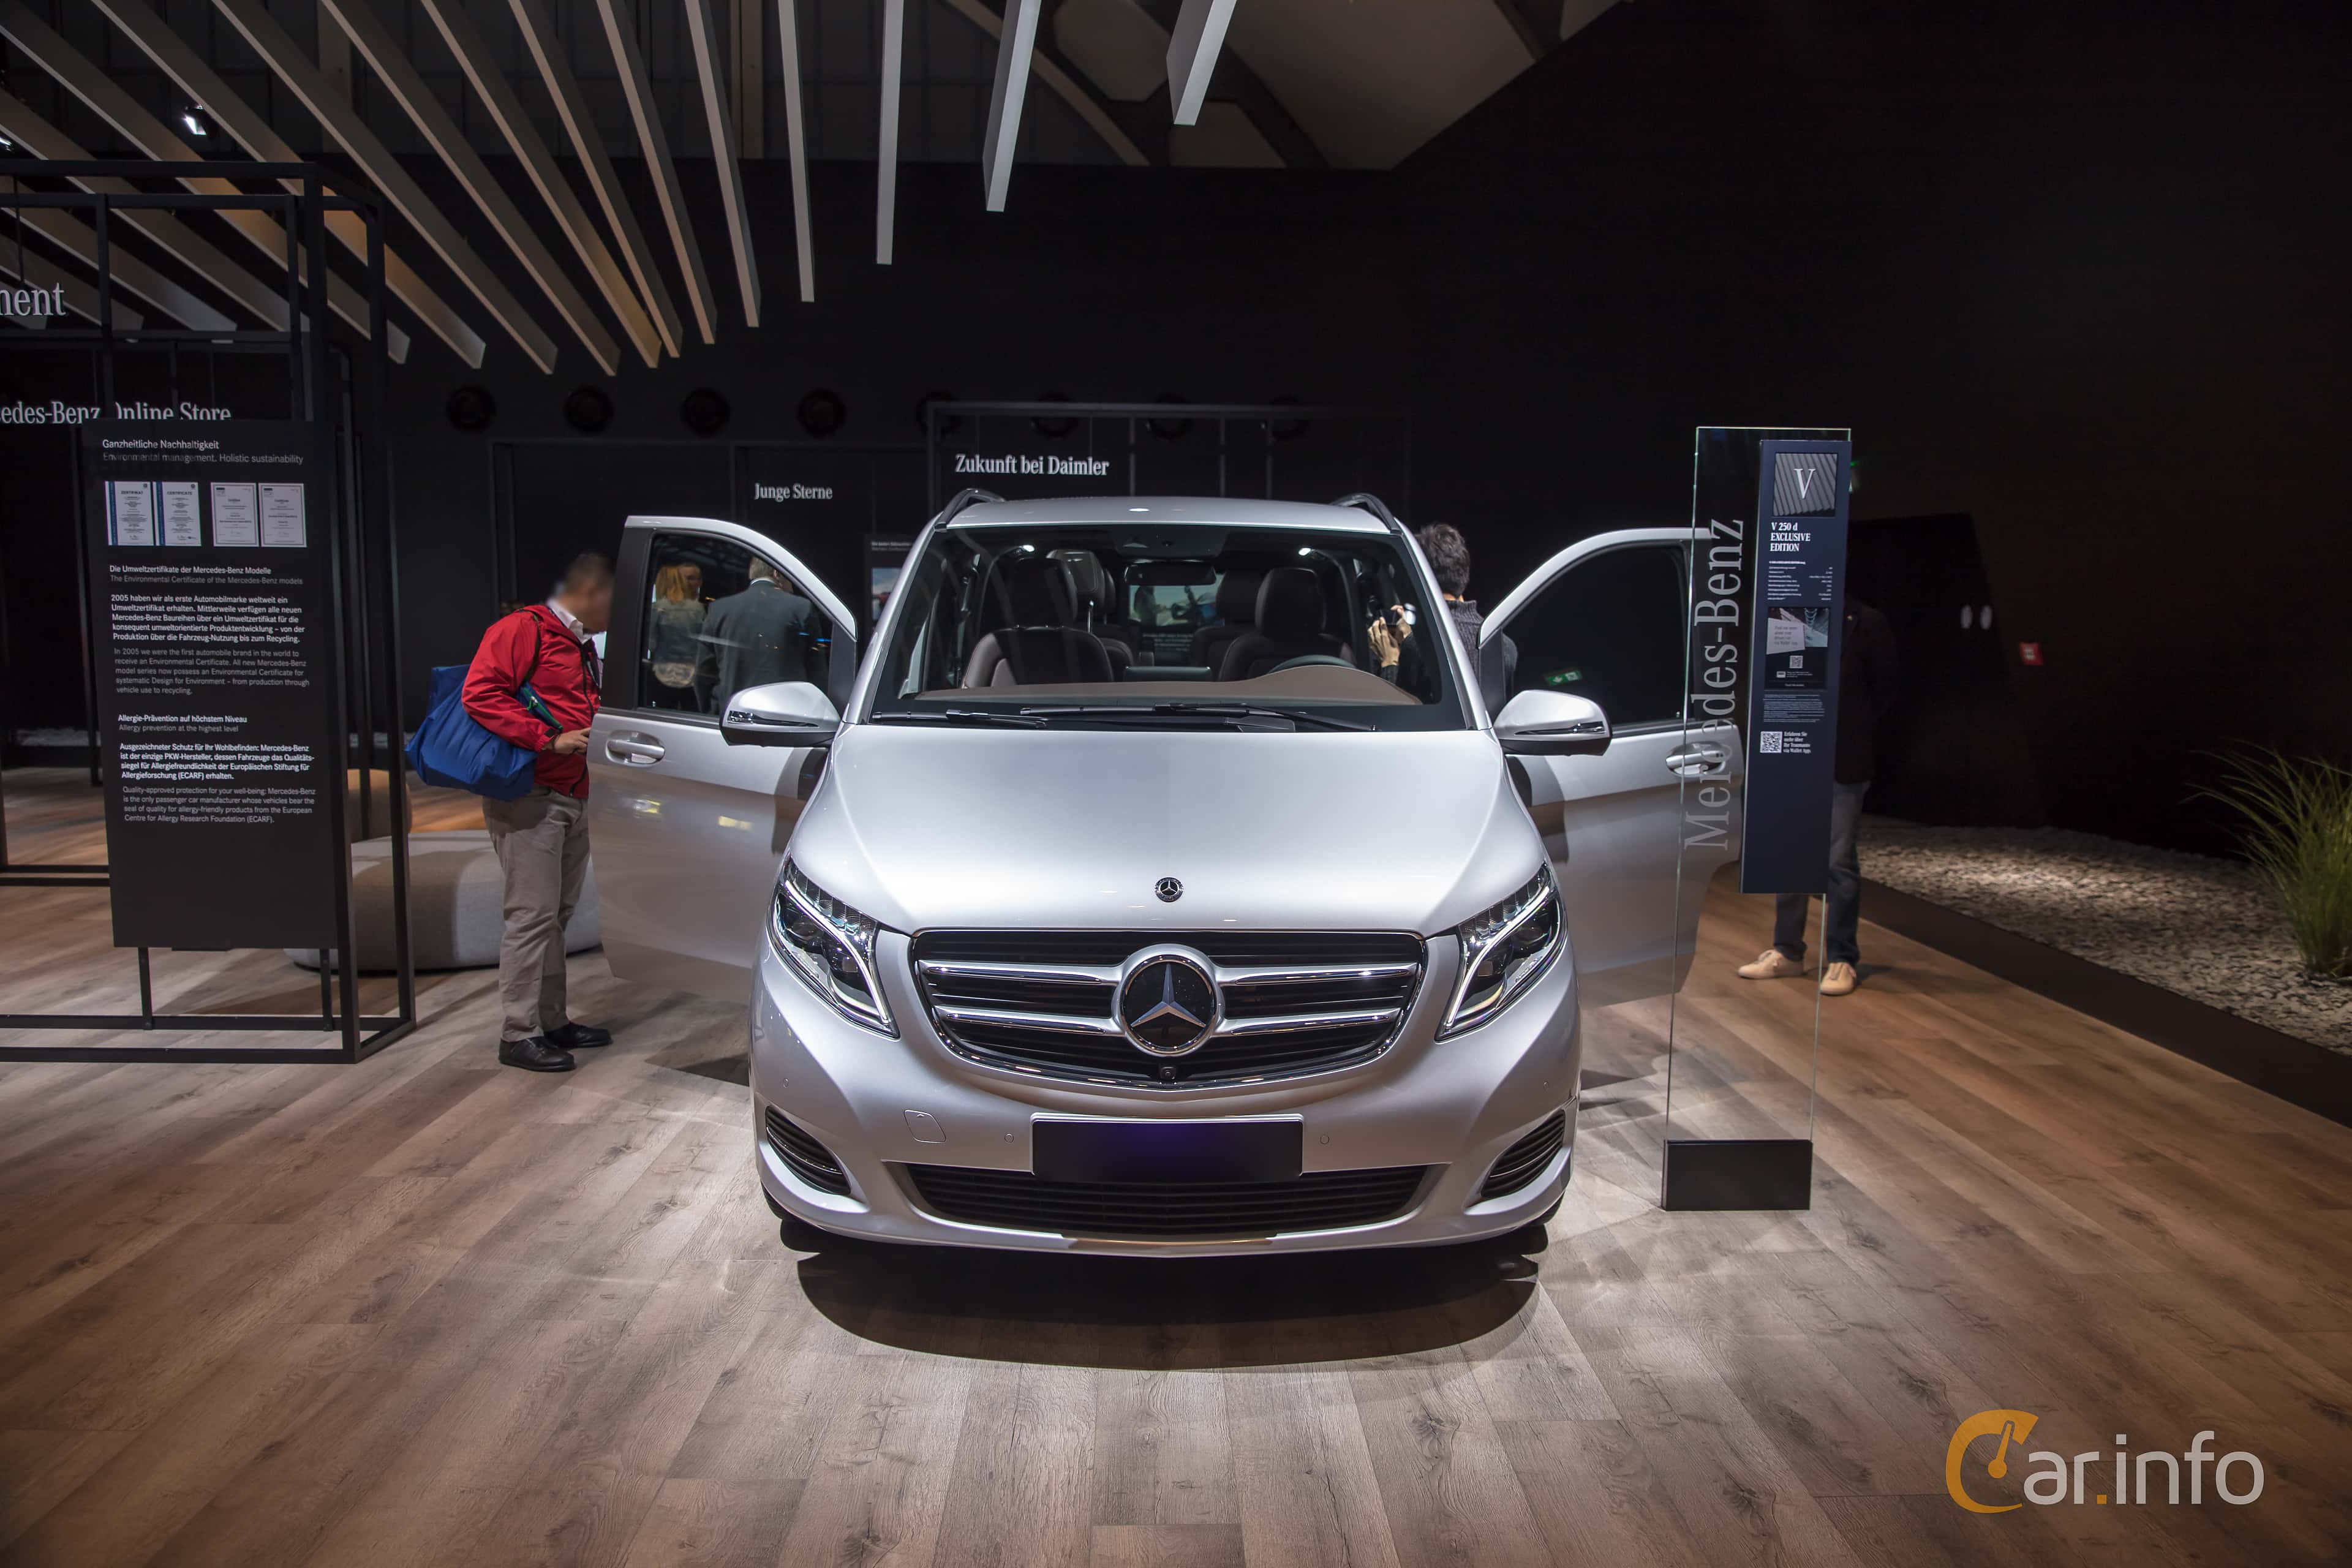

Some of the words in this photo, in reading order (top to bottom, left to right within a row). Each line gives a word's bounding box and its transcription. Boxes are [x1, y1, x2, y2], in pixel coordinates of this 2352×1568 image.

[0, 401, 101, 424] edes-Benz
[180, 402, 232, 420] Store
[102, 439, 158, 449] Ganzheitliche
[160, 439, 220, 451] Nachhaltigkeit
[103, 453, 160, 461] Environmental
[162, 453, 217, 464] management.
[219, 453, 249, 462] Holistic
[251, 454, 303, 465] sustainability
[956, 454, 1017, 473] Zukunft
[1020, 455, 1044, 474] bei
[1047, 456, 1109, 476] Daimler
[1793, 468, 1816, 499] V
[755, 483, 790, 502] Junge
[792, 484, 832, 499] Sterne
[1771, 522, 1777, 531] V
[1778, 522, 1792, 531] 250
[1792, 522, 1798, 531] d
[1770, 533, 1811, 542] EXCLUSIVE
[1770, 543, 1800, 552] EDITION
[238, 605, 266, 614] verfügen
[113, 624, 151, 632] konsequent
[179, 634, 239, 643] Fahrzeug-Nutzung
[266, 635, 300, 644] Recycling.
[1683, 519, 1744, 850] Mercedes-Benz
[118, 715, 179, 723] Allergie-Prävention
[141, 753, 163, 761] einzige
[238, 754, 271, 763] Fahrzeuge
[151, 763, 217, 771] Allergiefreundlichkeit
[230, 763, 273, 772] Europäischen
[178, 772, 205, 780] (ECARF)
